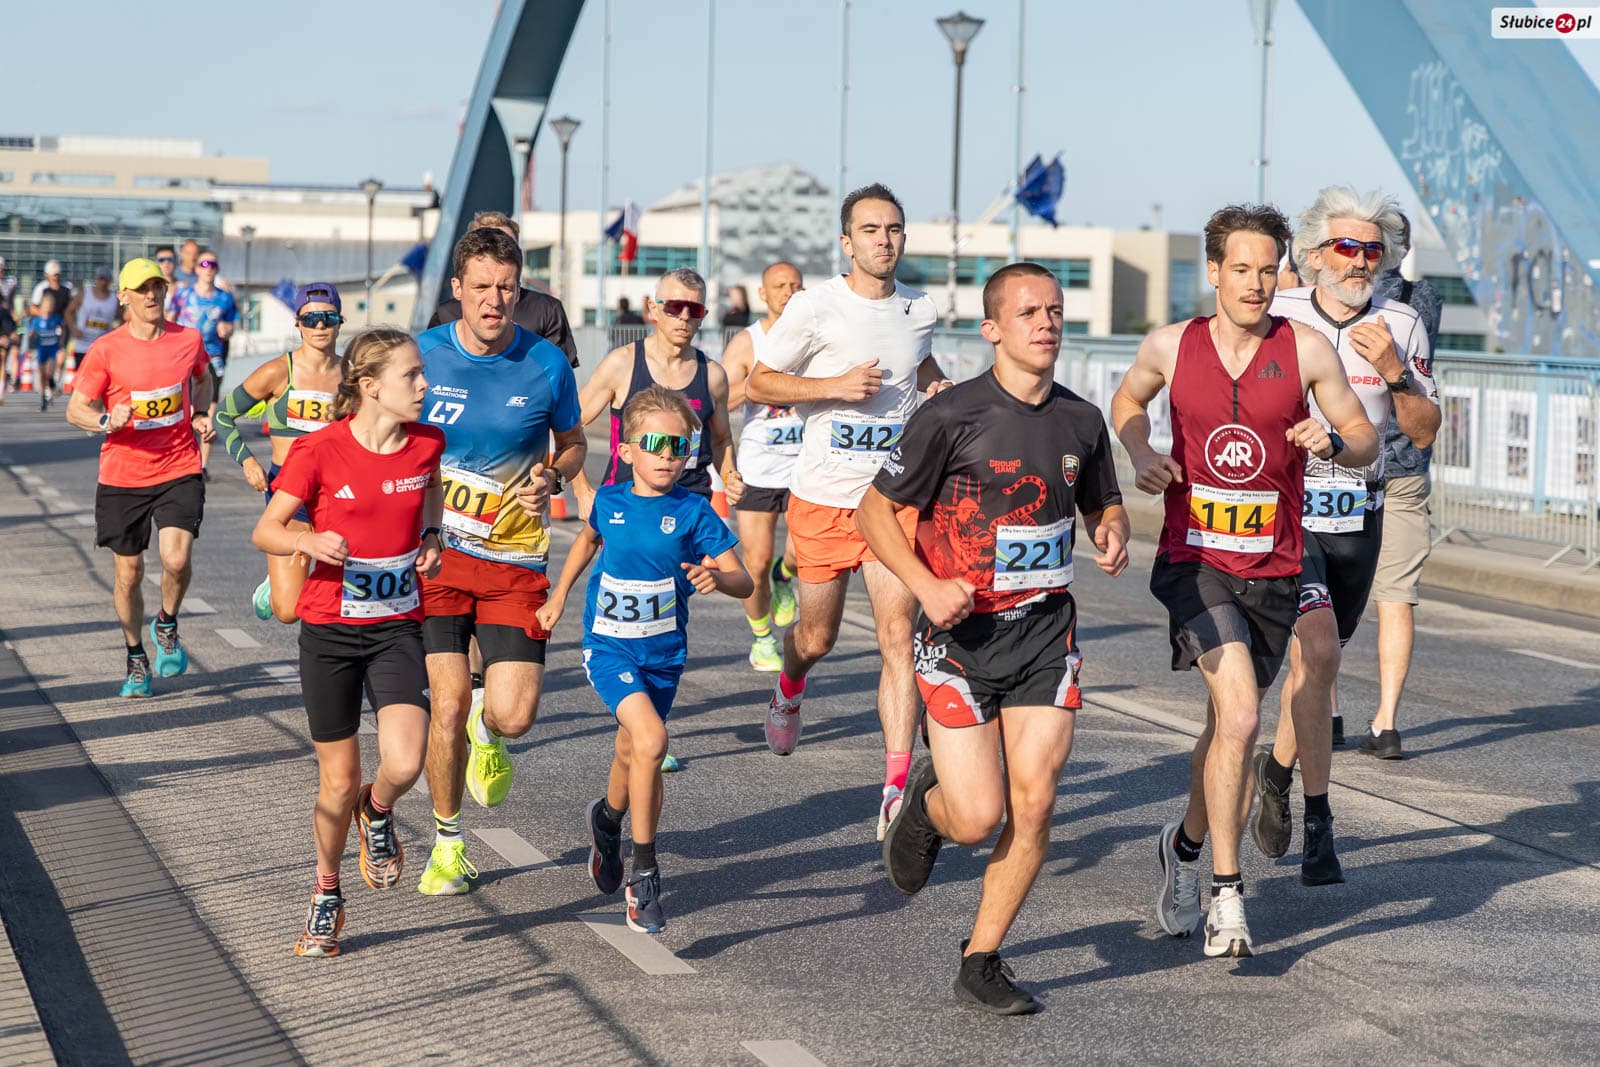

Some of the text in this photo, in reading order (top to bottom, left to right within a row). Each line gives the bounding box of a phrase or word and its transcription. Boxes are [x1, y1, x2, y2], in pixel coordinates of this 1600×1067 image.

[1348, 375, 1382, 387] DER
[147, 397, 172, 418] 82
[428, 400, 465, 425] 47
[838, 424, 893, 451] 342
[989, 458, 1021, 468] GROUND
[1214, 441, 1254, 467] AR
[994, 466, 1017, 474] GAME
[1202, 502, 1264, 534] 114
[1006, 535, 1065, 572] 221
[353, 568, 412, 600] 308
[603, 591, 660, 622] 231
